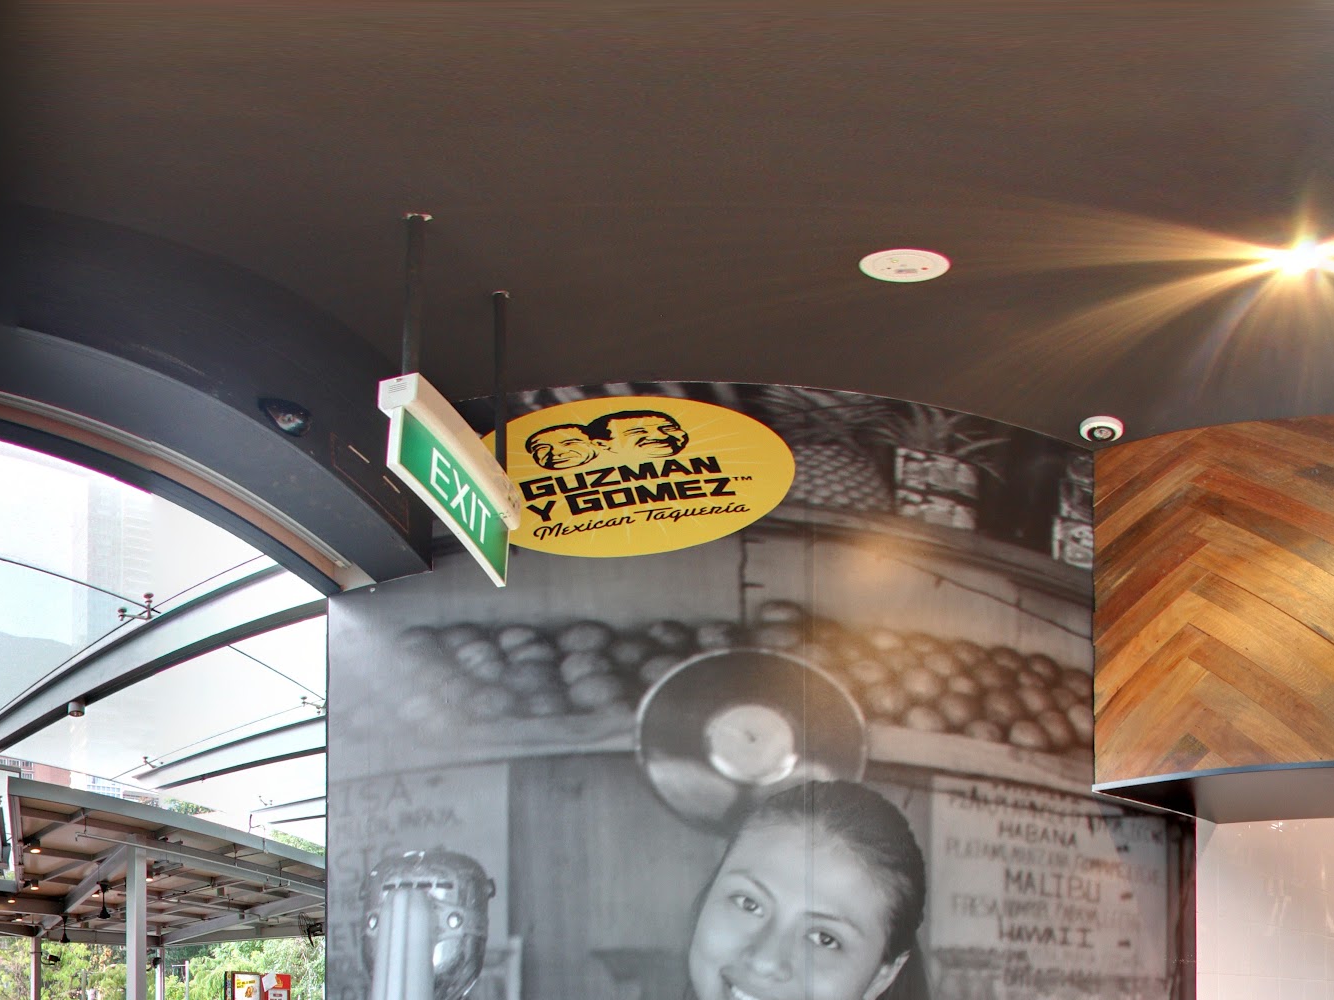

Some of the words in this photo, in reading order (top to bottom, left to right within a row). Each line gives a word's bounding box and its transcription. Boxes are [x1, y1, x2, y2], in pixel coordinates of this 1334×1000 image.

[519, 456, 722, 502] GUZMAN
[430, 446, 491, 545] EXIT
[527, 500, 557, 522] Y
[533, 514, 635, 541] Mexican
[998, 820, 1078, 849] HABANA
[1003, 868, 1100, 903] MALIBU
